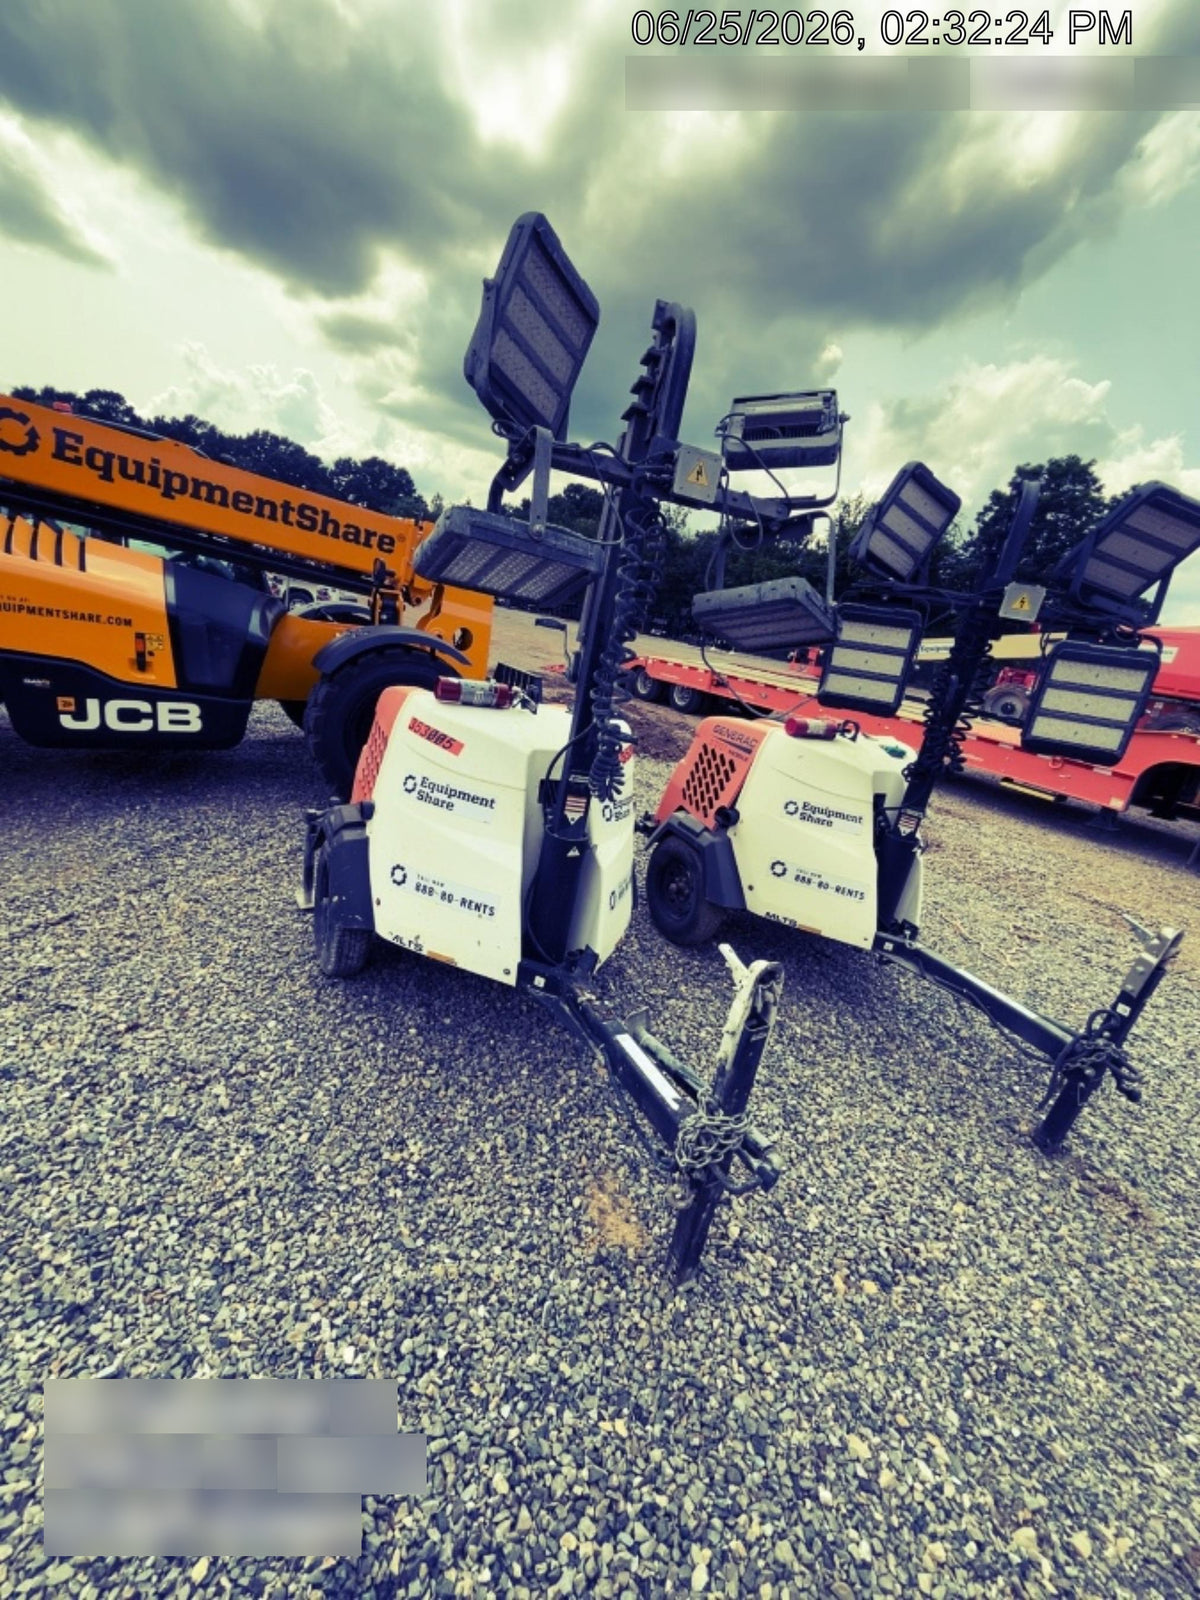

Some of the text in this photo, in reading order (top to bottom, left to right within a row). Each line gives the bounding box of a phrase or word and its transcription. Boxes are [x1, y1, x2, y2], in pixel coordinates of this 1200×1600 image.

[51, 426, 396, 554] EquipmentShare
[59, 697, 203, 733] JCB
[416, 788, 455, 812] Share
[420, 776, 496, 810] Equipment
[799, 811, 834, 828] Share
[801, 801, 863, 825] Equipment
[414, 881, 496, 917] 888-80-RENTS
